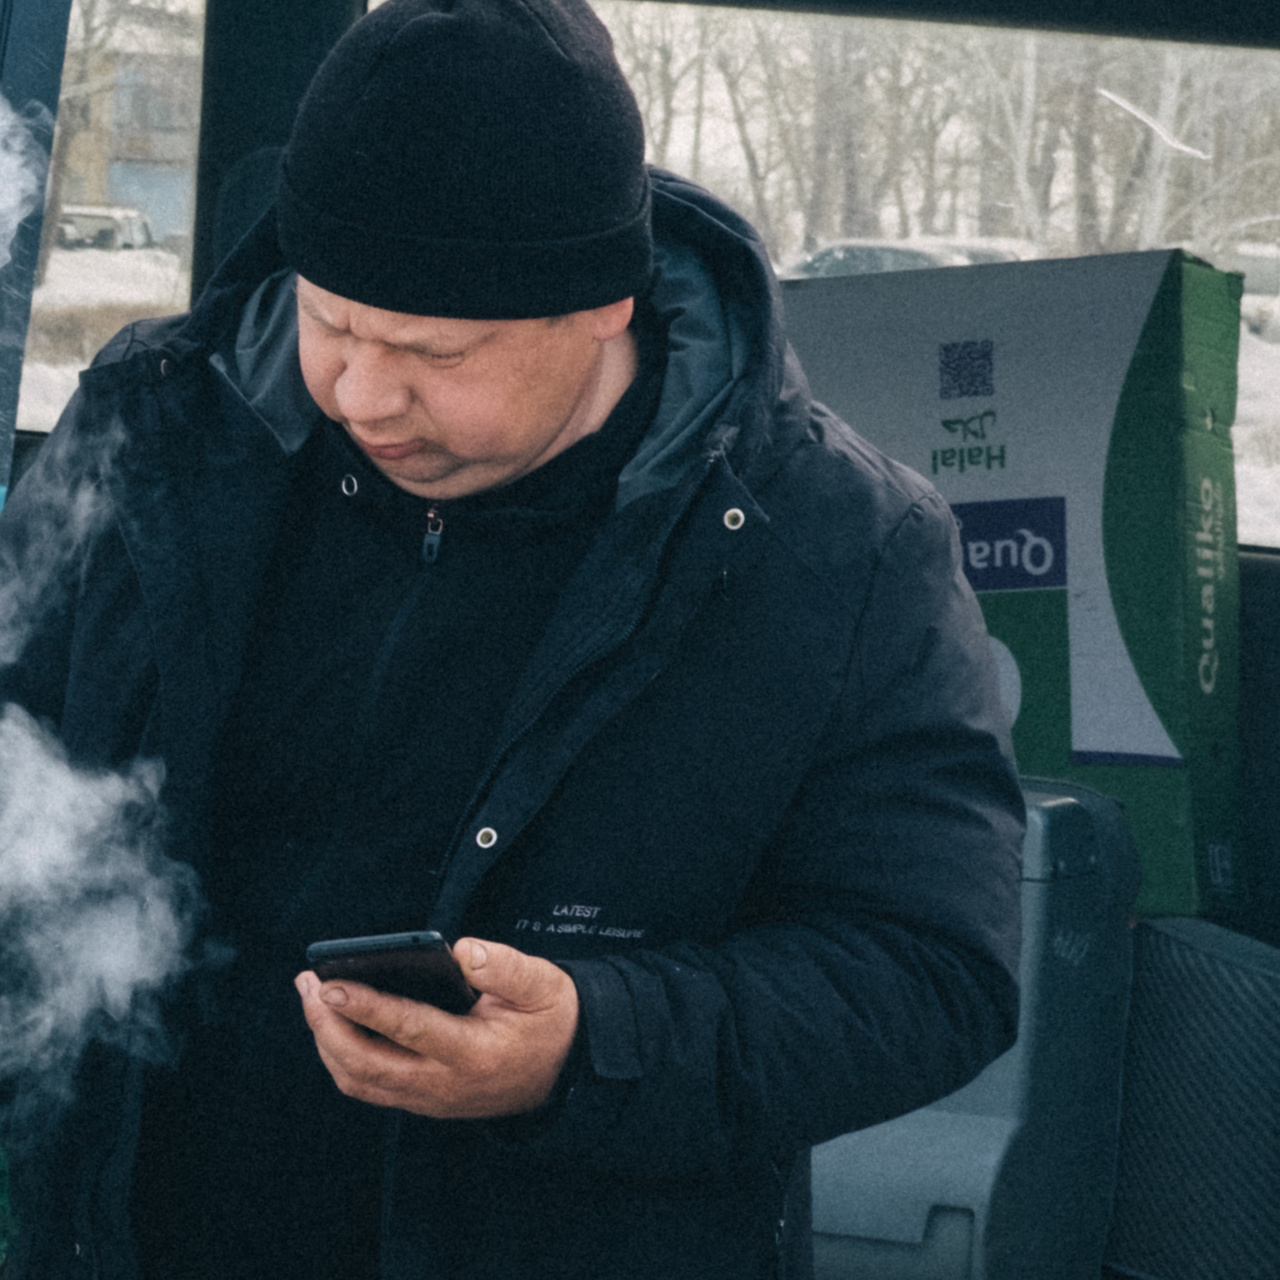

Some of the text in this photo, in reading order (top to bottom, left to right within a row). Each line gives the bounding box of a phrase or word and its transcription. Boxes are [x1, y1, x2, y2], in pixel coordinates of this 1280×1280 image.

[940, 410, 997, 442] حلال
[931, 444, 1006, 475] Halal
[967, 528, 1054, 576] Qua
[1196, 476, 1220, 695] Qualiko
[552, 904, 601, 918] LATEST
